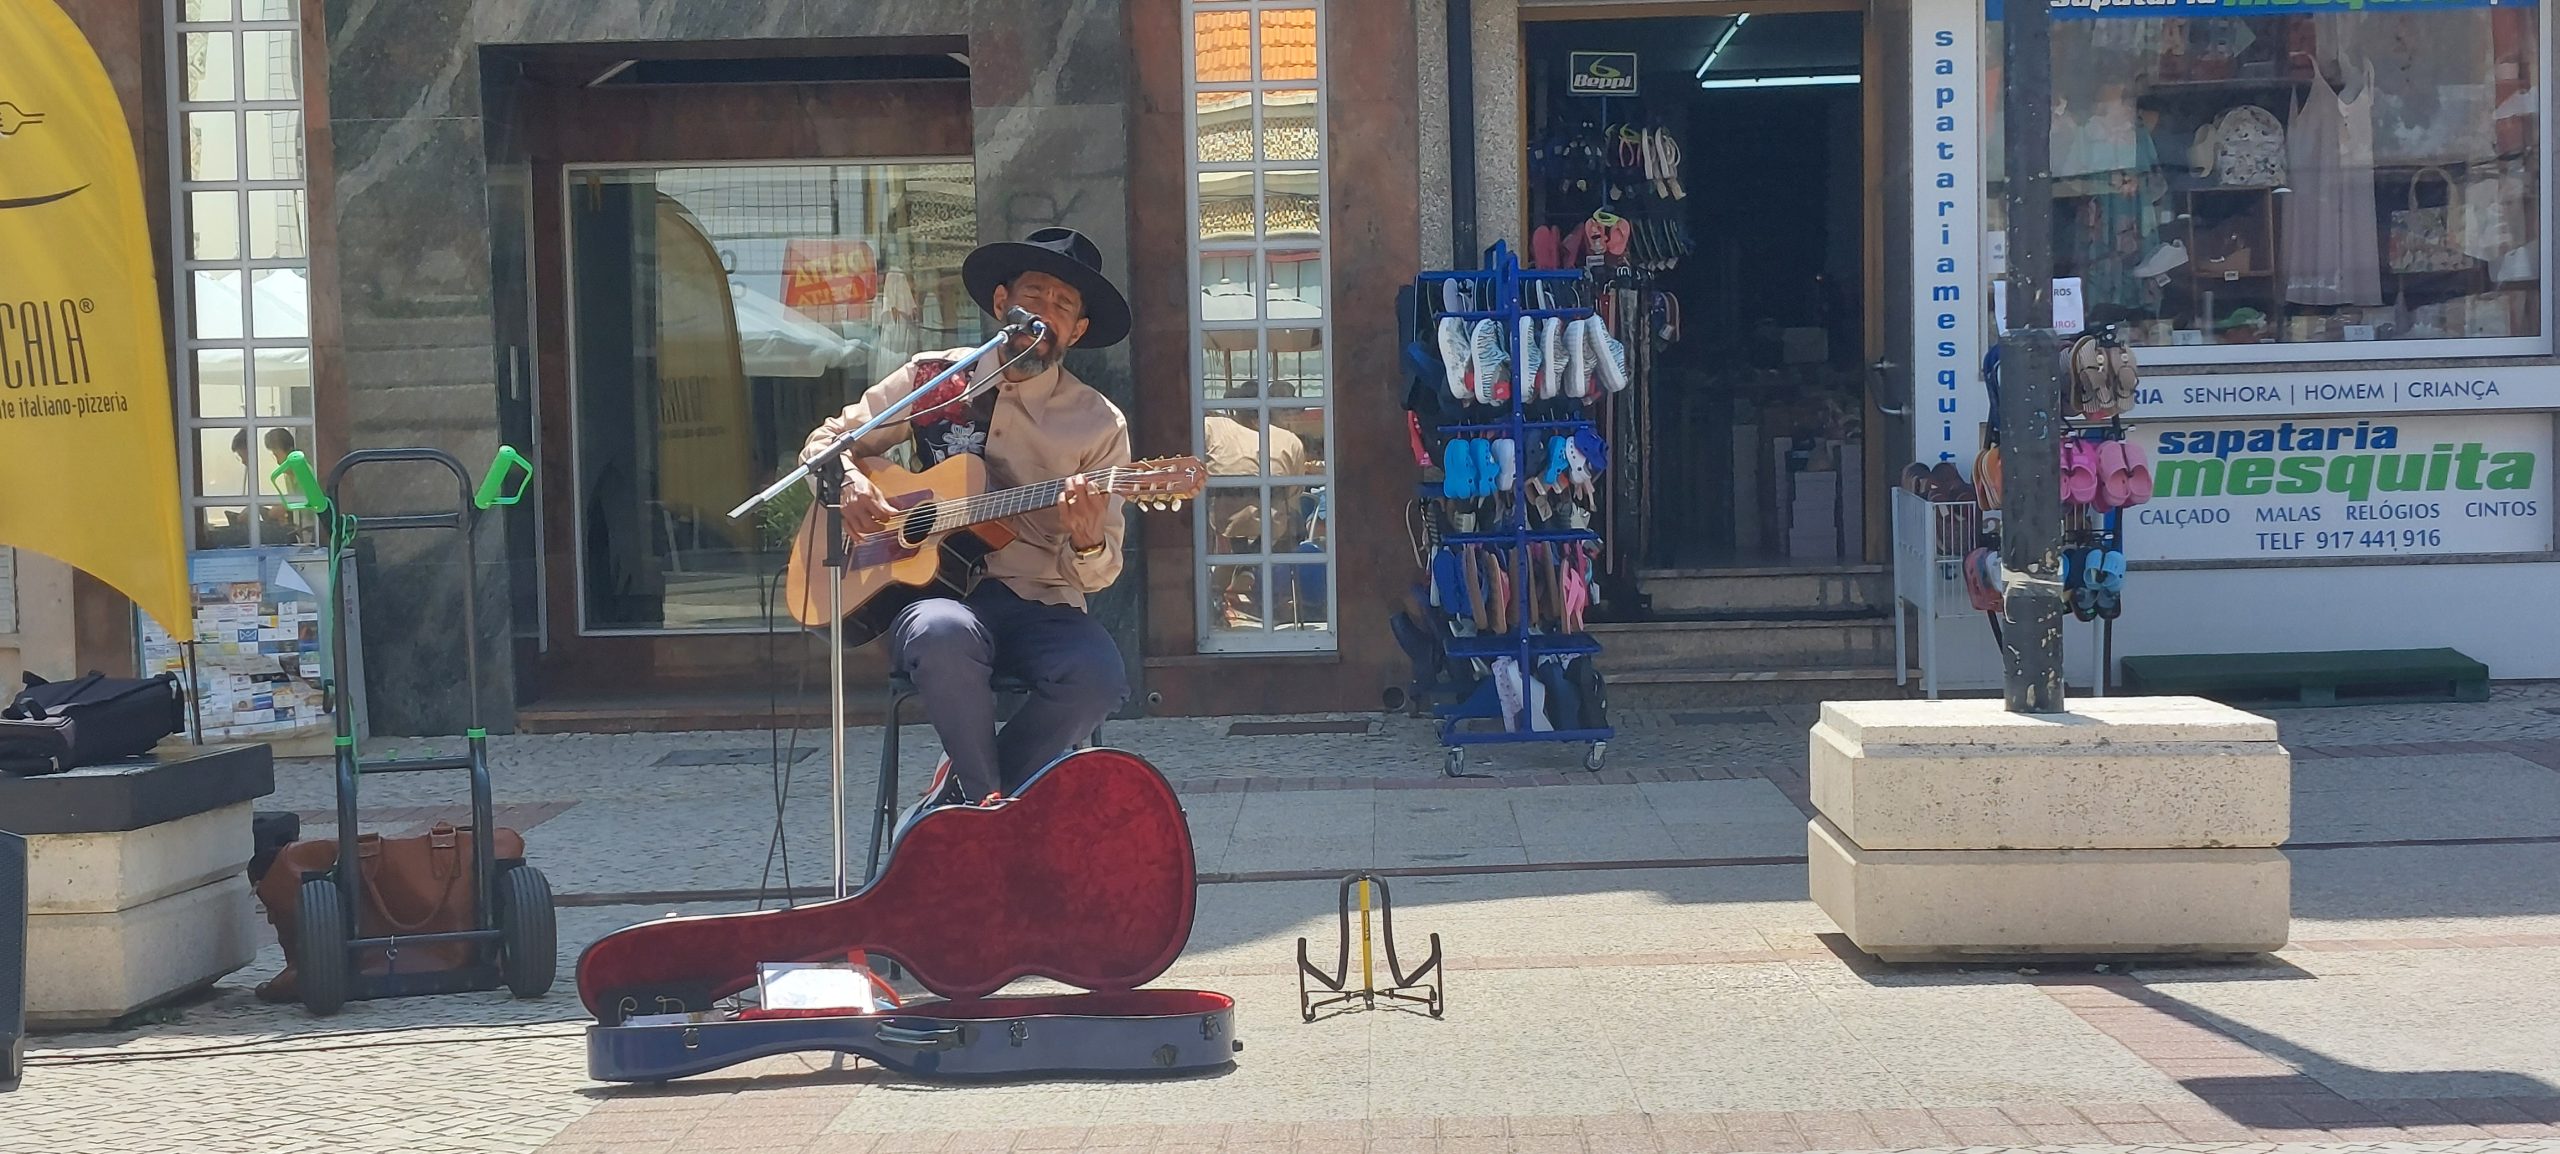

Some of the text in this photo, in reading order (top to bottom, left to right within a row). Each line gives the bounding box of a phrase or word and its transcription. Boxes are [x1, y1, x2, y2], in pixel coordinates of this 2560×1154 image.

[2053, 288, 2072, 297] ROS
[19, 391, 128, 418] italiano-pizzeria
[2133, 380, 2500, 405] RIA SENHORA HOMEM CRIANÇA
[2157, 420, 2399, 460] sapataria
[2152, 442, 2537, 502] mesquita
[2139, 500, 2538, 529] CALÇADO MALAS RELÓGIOS CINTOS
[2256, 529, 2441, 550] TELF 917 441 916
